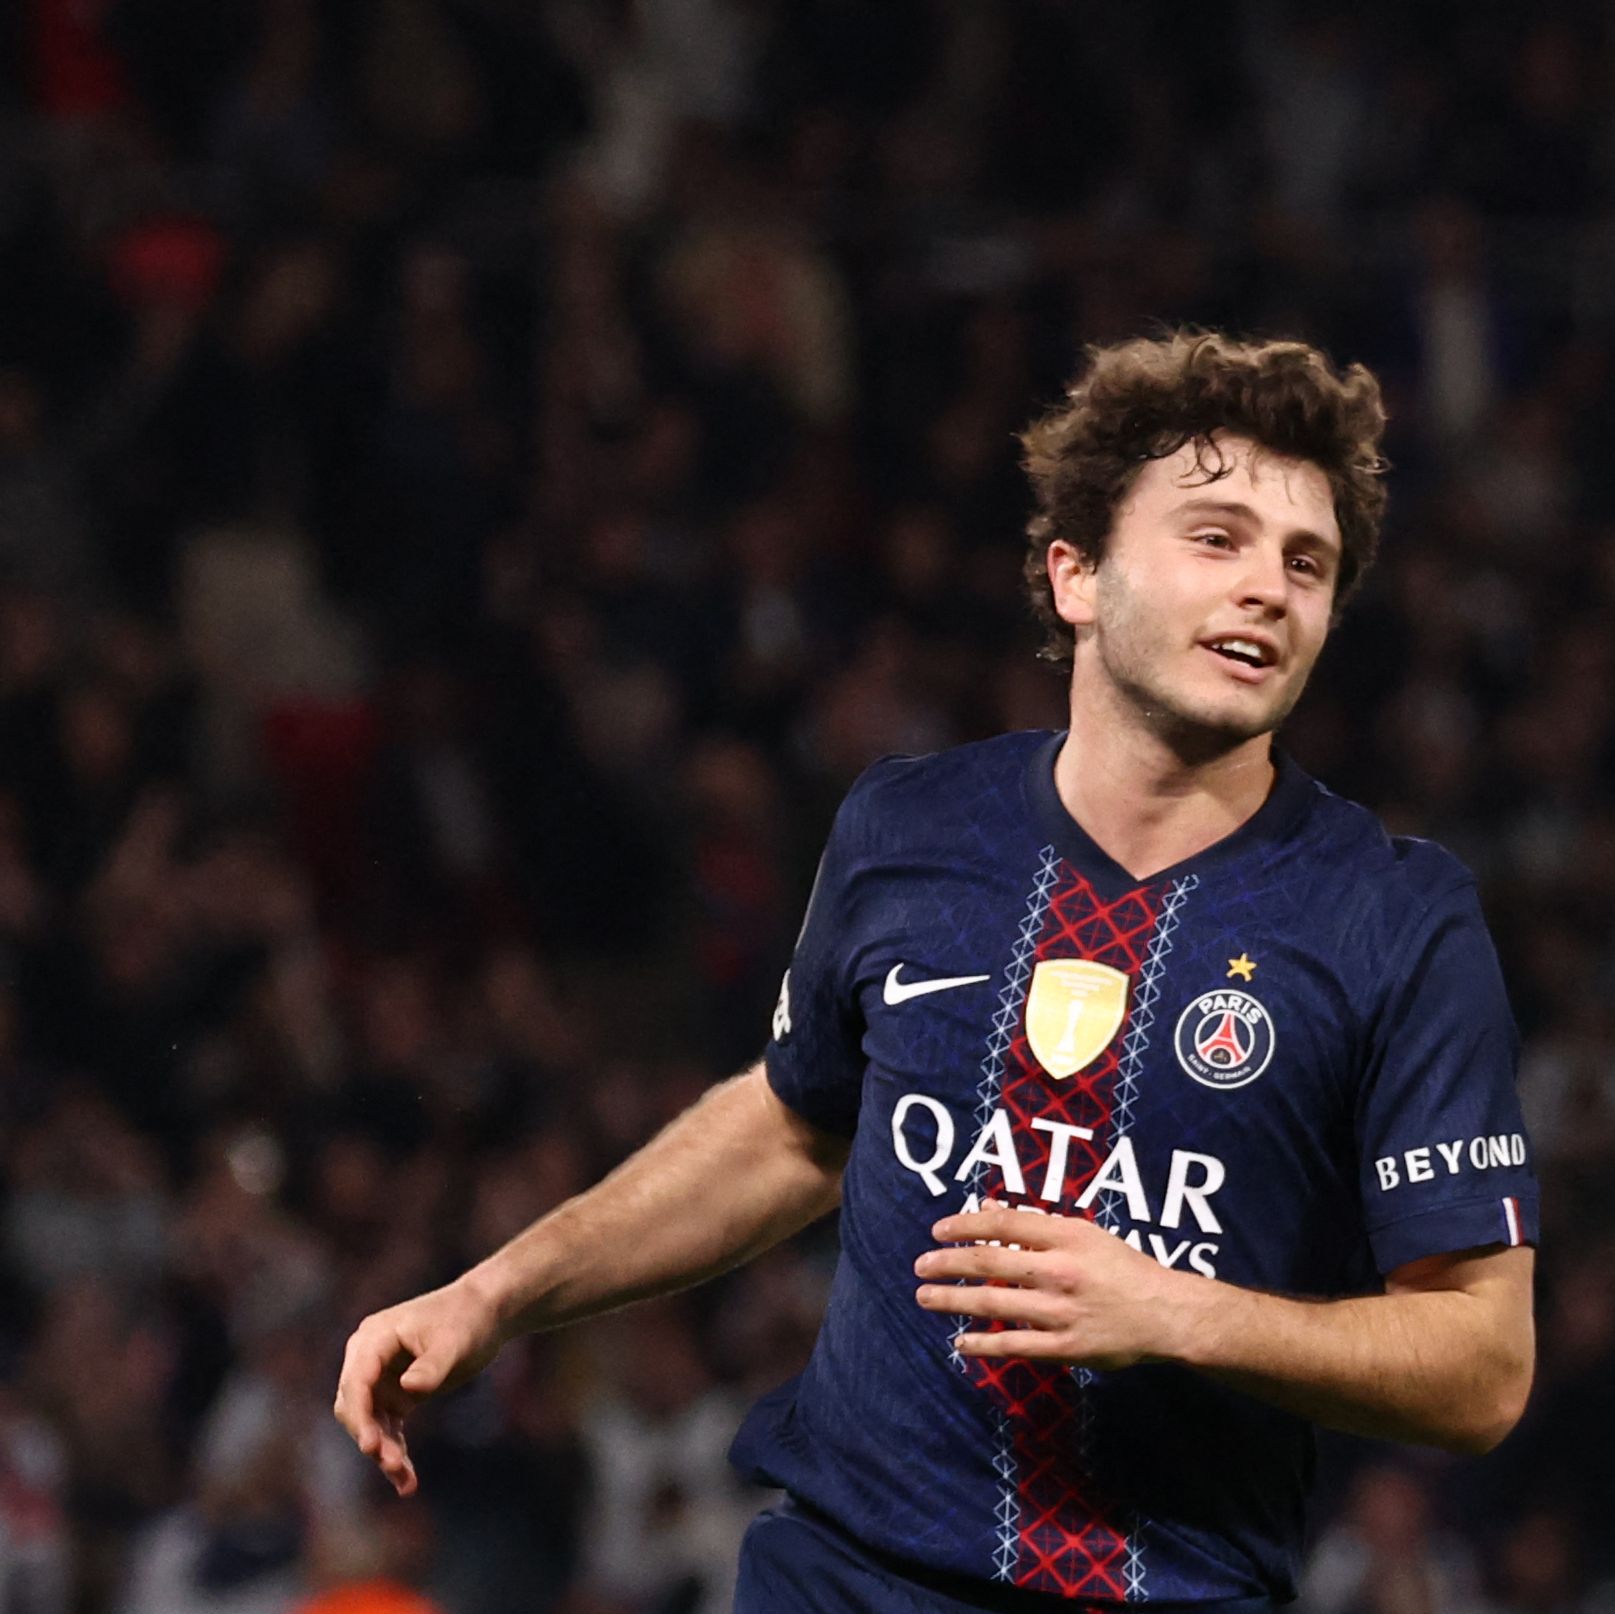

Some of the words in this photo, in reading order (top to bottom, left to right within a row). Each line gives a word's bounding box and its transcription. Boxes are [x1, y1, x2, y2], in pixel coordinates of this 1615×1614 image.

[1198, 995, 1263, 1024] PARIS
[891, 1093, 1226, 1235] QATAR
[1375, 1133, 1527, 1192] BEYOND
